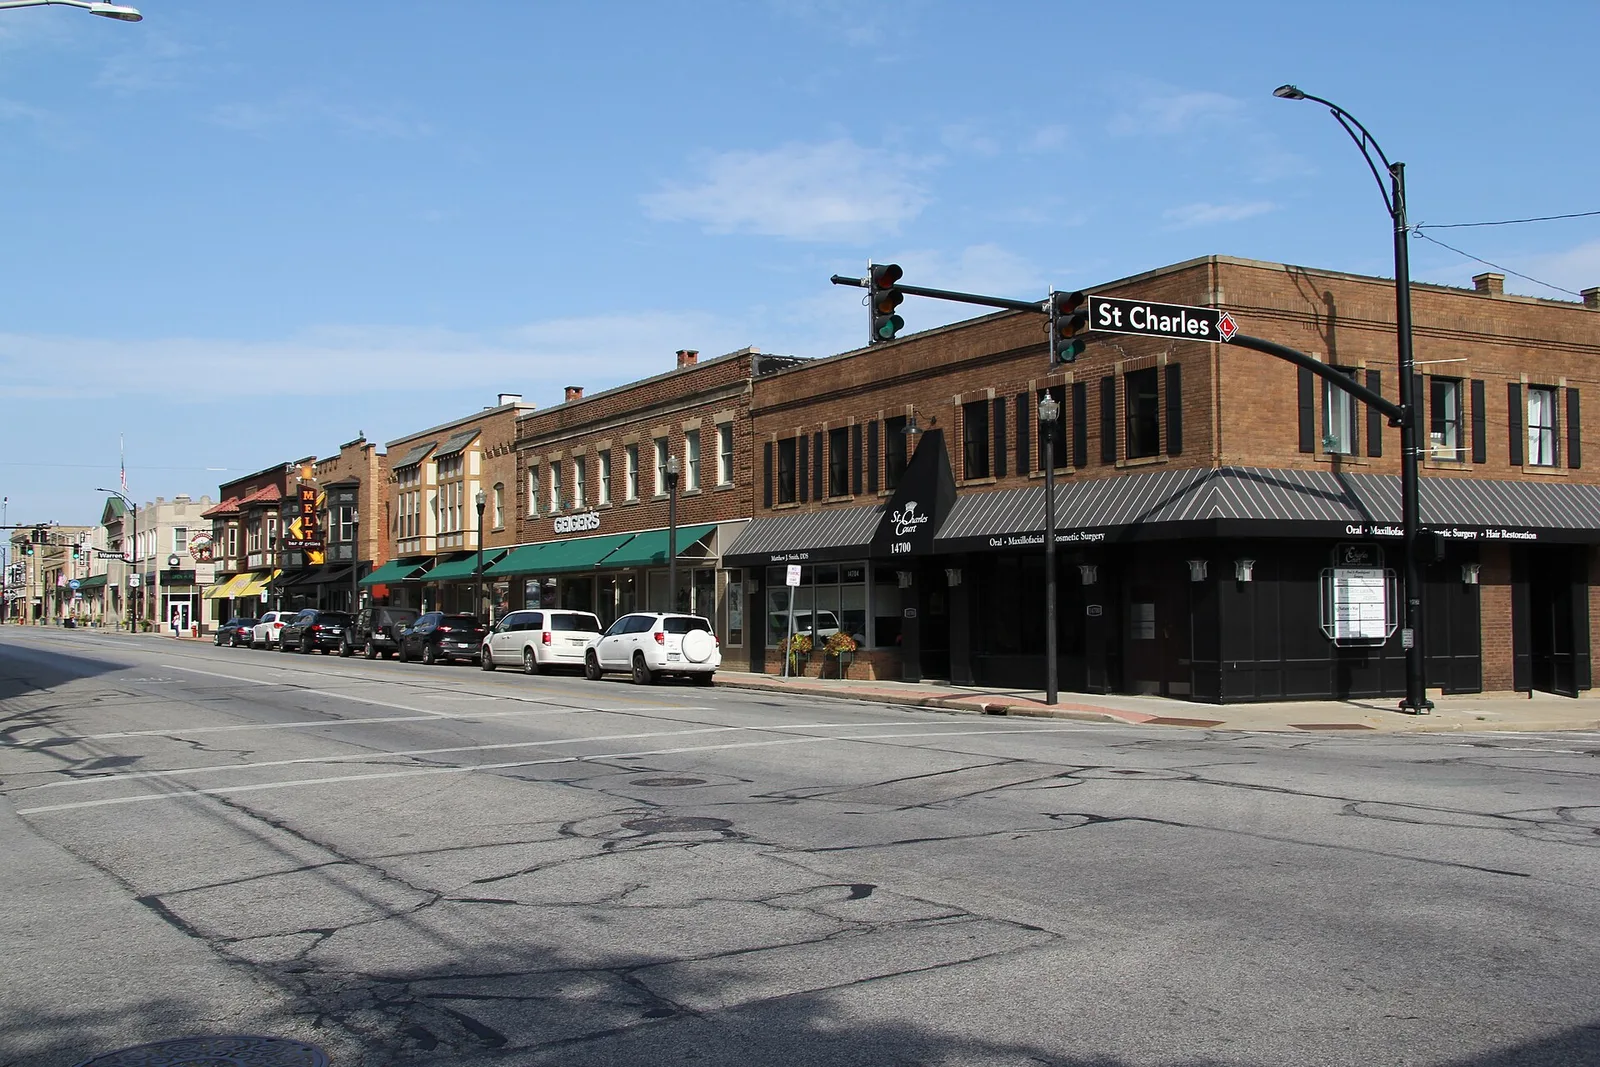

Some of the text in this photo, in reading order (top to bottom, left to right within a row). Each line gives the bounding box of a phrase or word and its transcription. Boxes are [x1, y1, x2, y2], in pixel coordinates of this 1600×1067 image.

[1099, 303, 1209, 335] St Charles
[1223, 322, 1230, 331] L
[303, 490, 313, 539] MELT
[902, 510, 928, 525] Charles
[895, 522, 917, 535] Court
[1345, 525, 1362, 535] Oral
[1370, 525, 1404, 536] Maxillofac
[1452, 528, 1477, 539] Surgery
[1486, 529, 1501, 539] Hair
[1501, 529, 1537, 539] Restoration
[989, 531, 1105, 546] Oral Maxillofacial osmetic Surgery
[891, 542, 911, 553] 14700
